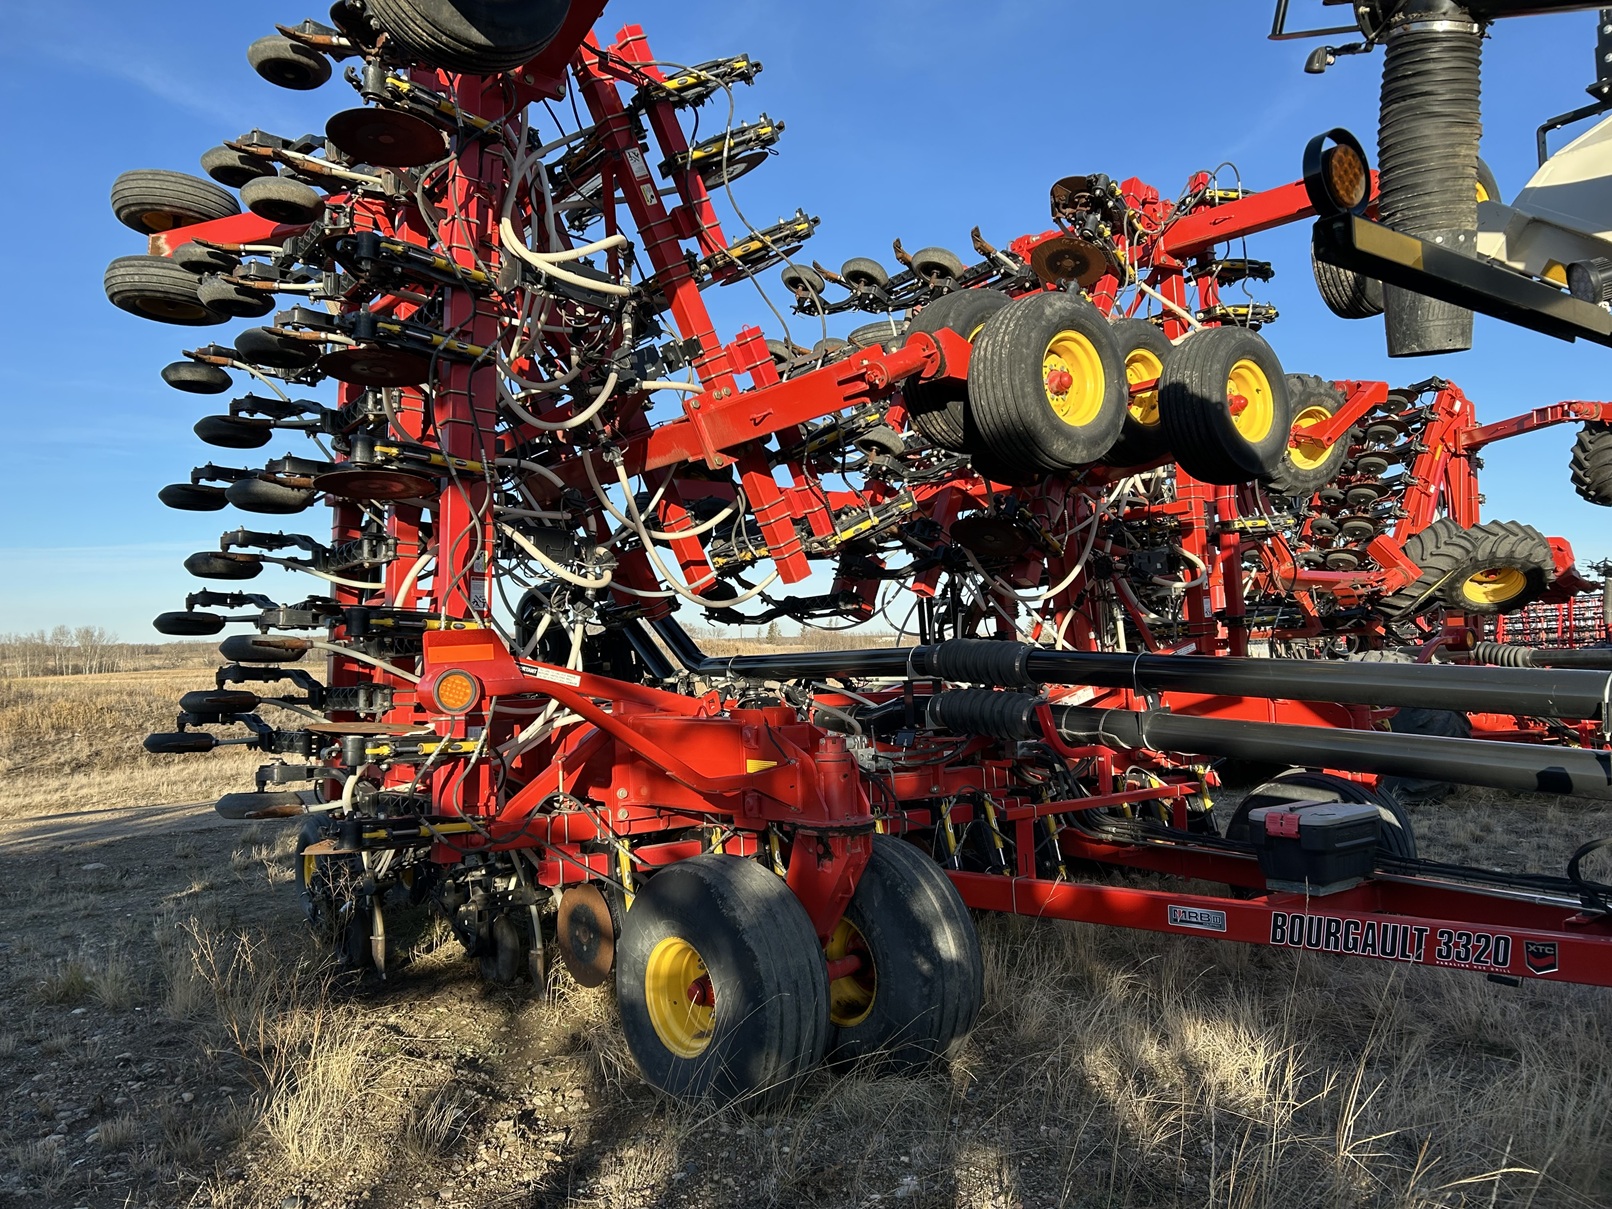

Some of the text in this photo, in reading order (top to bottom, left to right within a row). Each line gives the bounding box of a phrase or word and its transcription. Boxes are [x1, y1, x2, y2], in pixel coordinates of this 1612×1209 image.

[1173, 909, 1211, 922] MRB
[1270, 911, 1512, 968] BOURGAULT 3320
[1527, 944, 1555, 954] XTC
